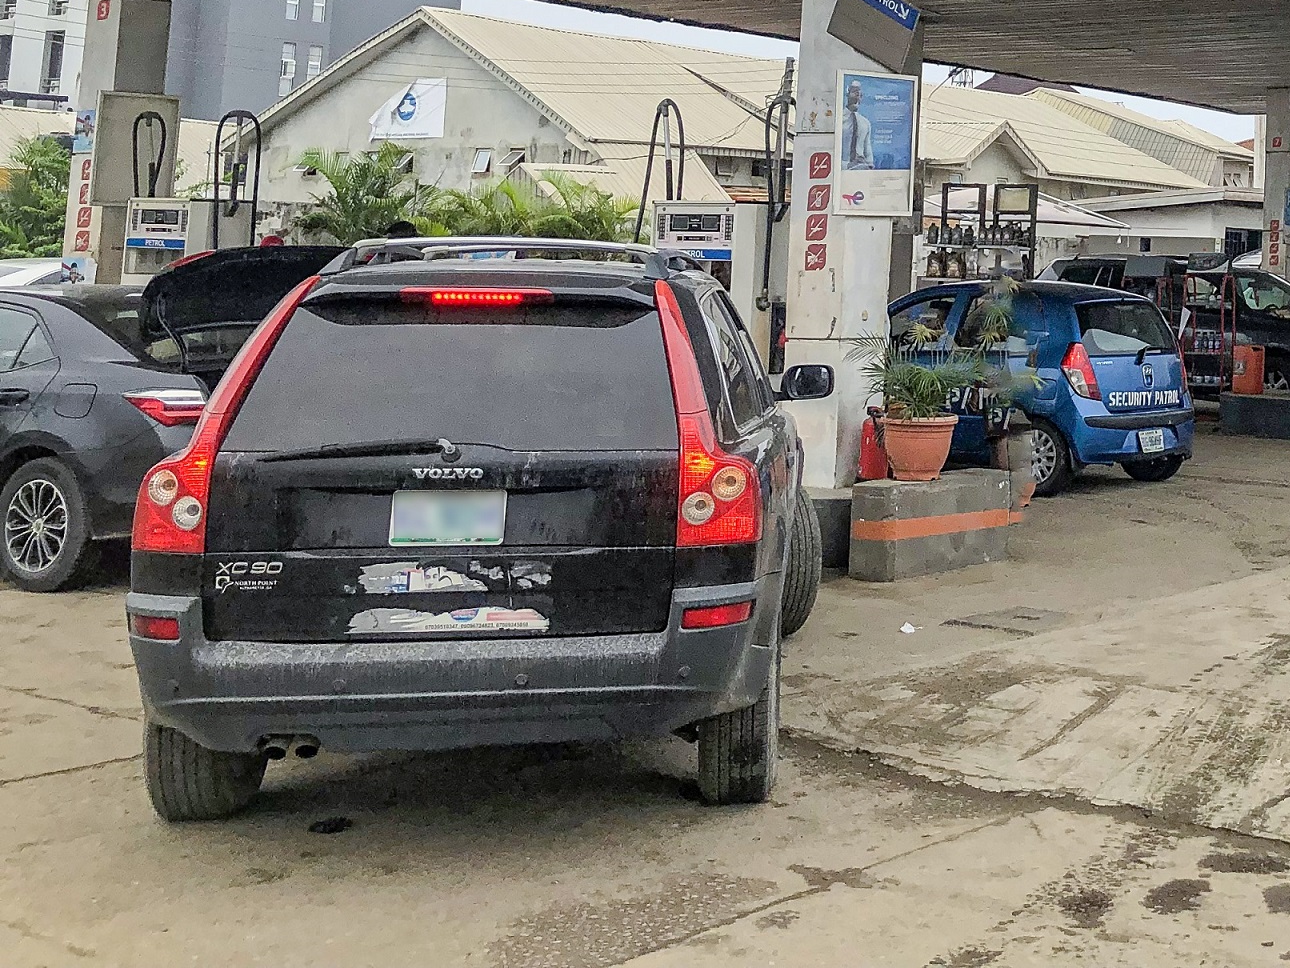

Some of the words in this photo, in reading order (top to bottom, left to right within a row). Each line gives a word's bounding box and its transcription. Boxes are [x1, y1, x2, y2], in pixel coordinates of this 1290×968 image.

[99, 2, 107, 17] 3
[144, 239, 166, 247] PETROL
[1108, 391, 1152, 407] SECURITY
[1154, 389, 1180, 405] PATROL
[411, 467, 484, 479] VOLVO
